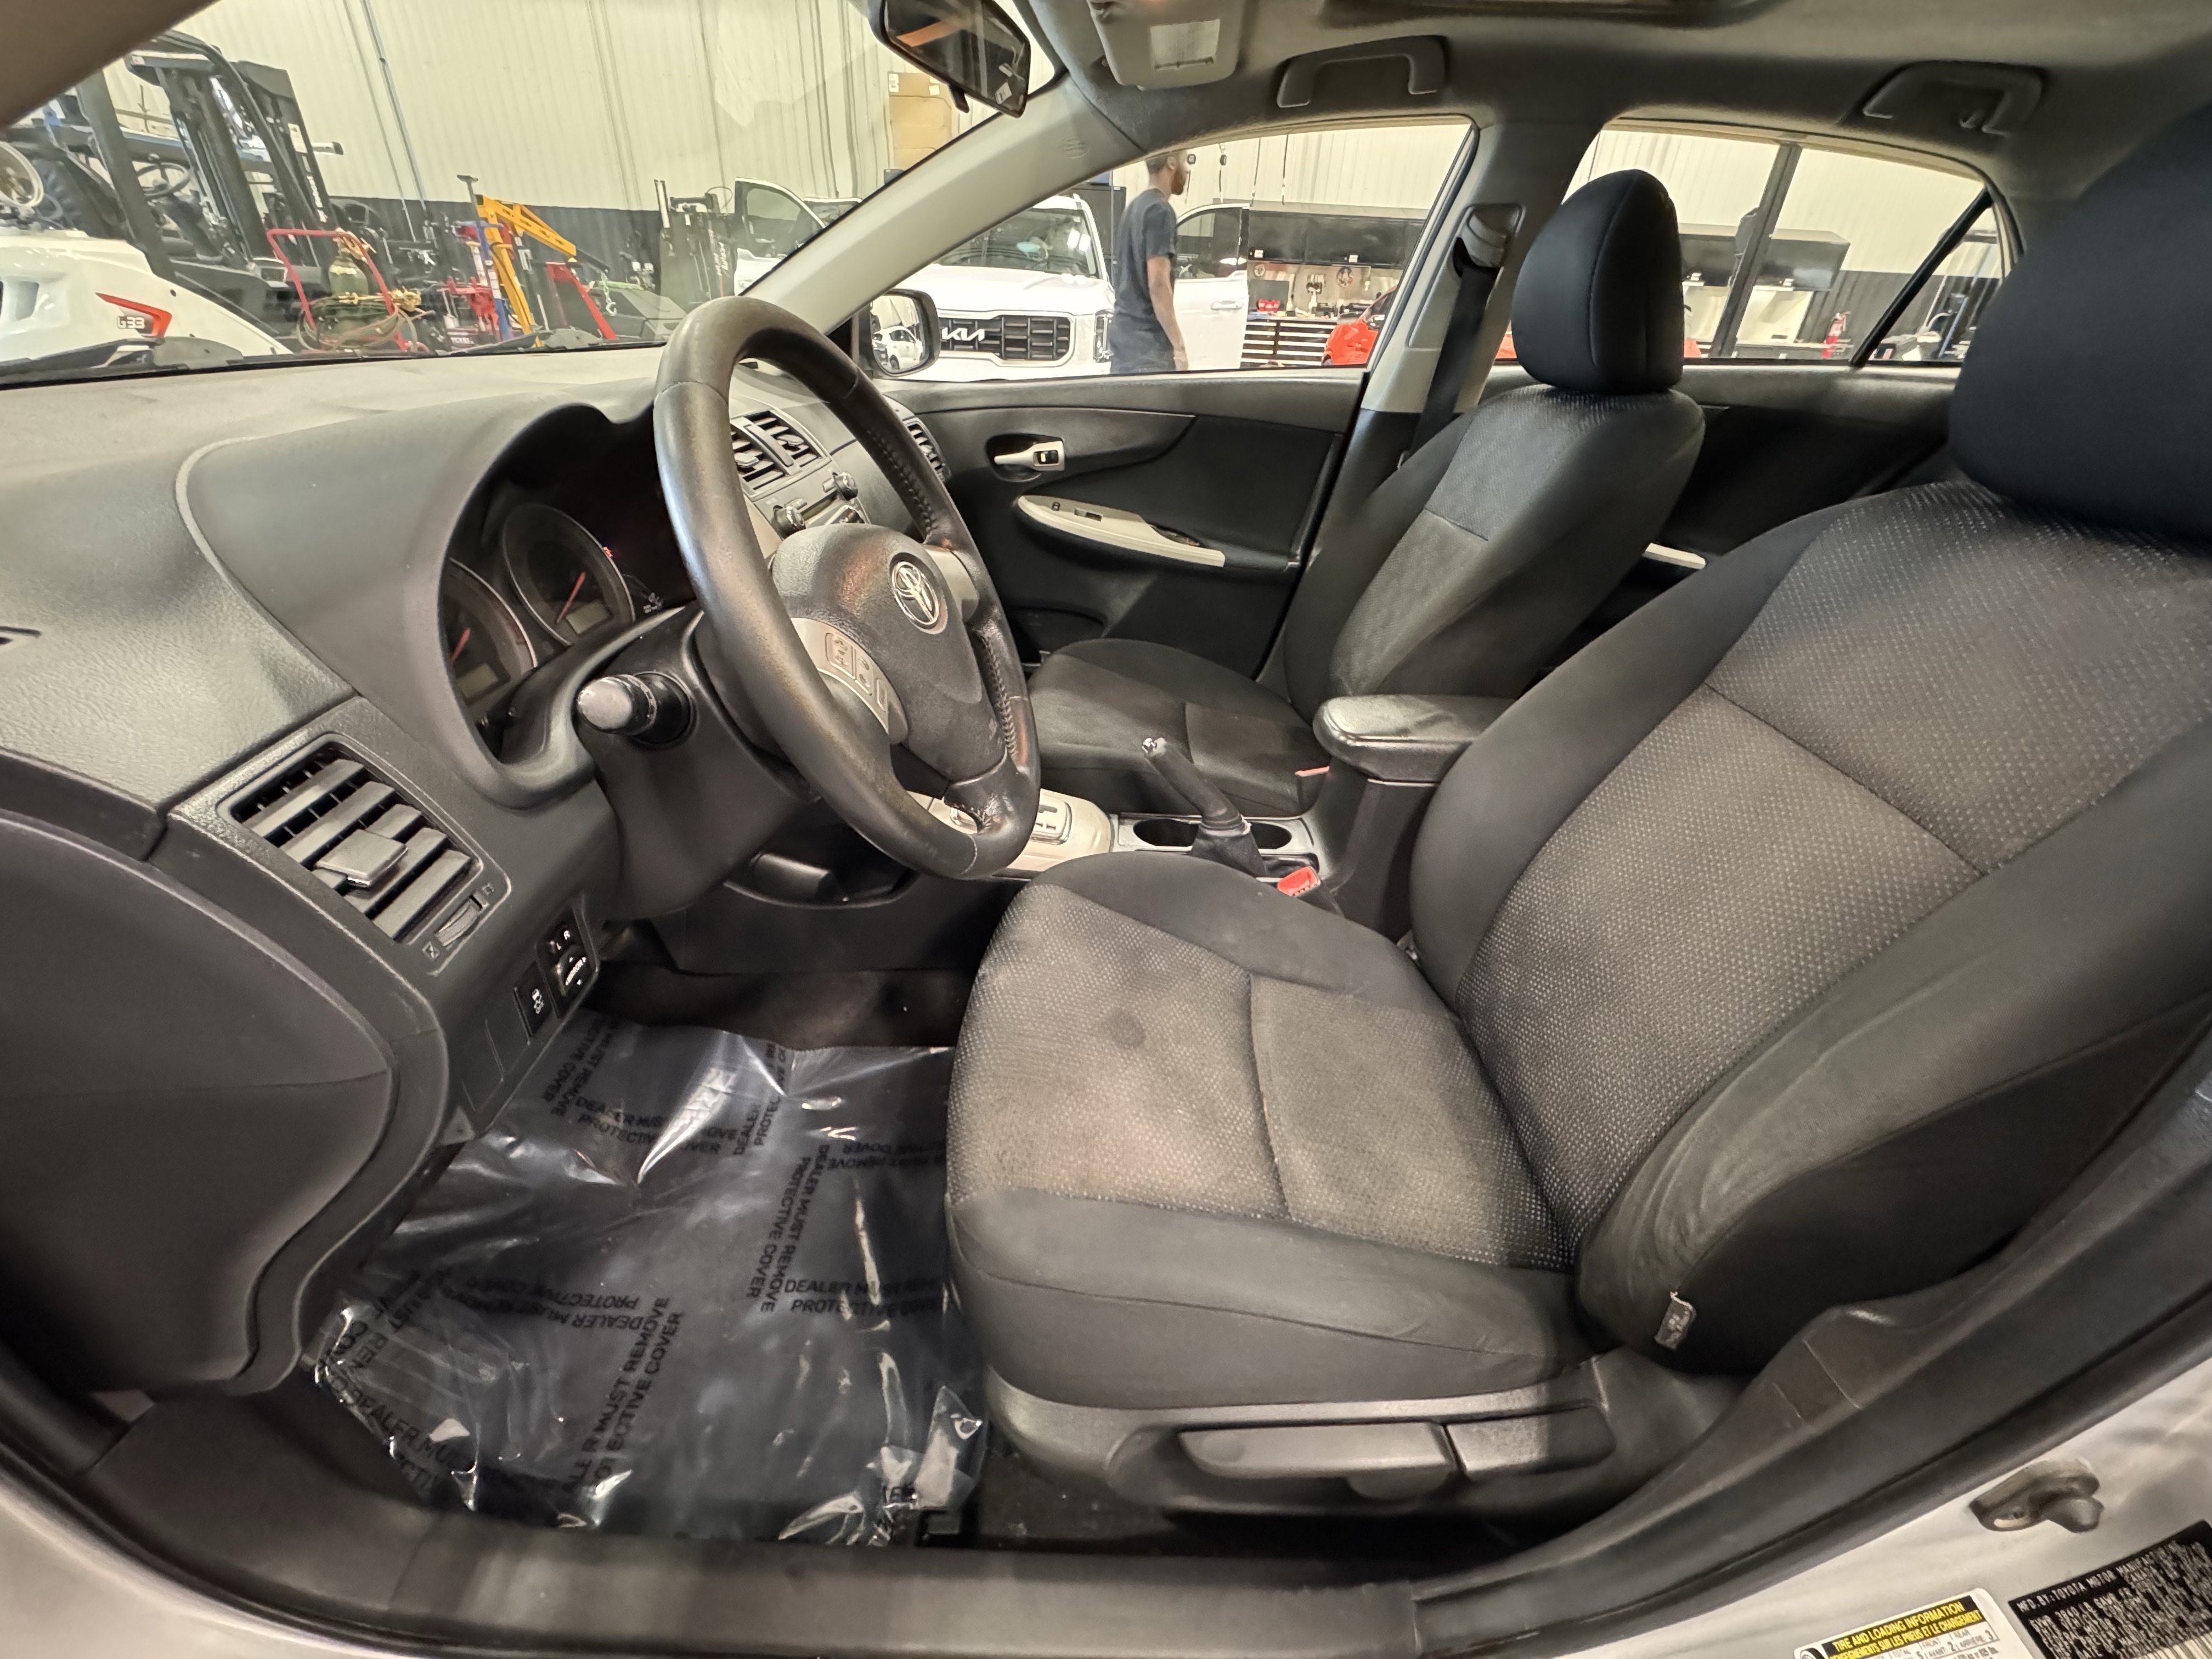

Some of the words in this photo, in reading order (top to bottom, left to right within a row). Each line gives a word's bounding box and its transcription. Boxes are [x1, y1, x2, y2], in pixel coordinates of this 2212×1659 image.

[117, 316, 145, 329] G33
[941, 327, 985, 341] KIA
[563, 930, 571, 940] R
[801, 1144, 830, 1195] DEALER
[768, 1156, 811, 1240] PROTECTIVE
[787, 1198, 812, 1241] MUST
[745, 1243, 777, 1300] COVER
[760, 1244, 797, 1312] REMOVE
[571, 1315, 643, 1329] DEALER
[622, 1297, 671, 1373] REMOVE
[644, 1311, 685, 1374] COVER
[2086, 1570, 2116, 1587] MOTOR
[1833, 1638, 1853, 1651] TIRE
[1850, 1633, 1870, 1645] AND
[1868, 1621, 1906, 1640] LOADING
[1904, 1601, 1964, 1628] INFORMATION
[1877, 1639, 1892, 1650] SUR
[1889, 1635, 1903, 1646] LES
[1901, 1629, 1923, 1643] PNEUS
[1921, 1626, 1932, 1636] ET
[1929, 1623, 1940, 1633] LE
[1938, 1610, 1982, 1631] CHARGEMENT
[1948, 1641, 1956, 1651] 2
[1985, 1630, 1993, 1639] 3
